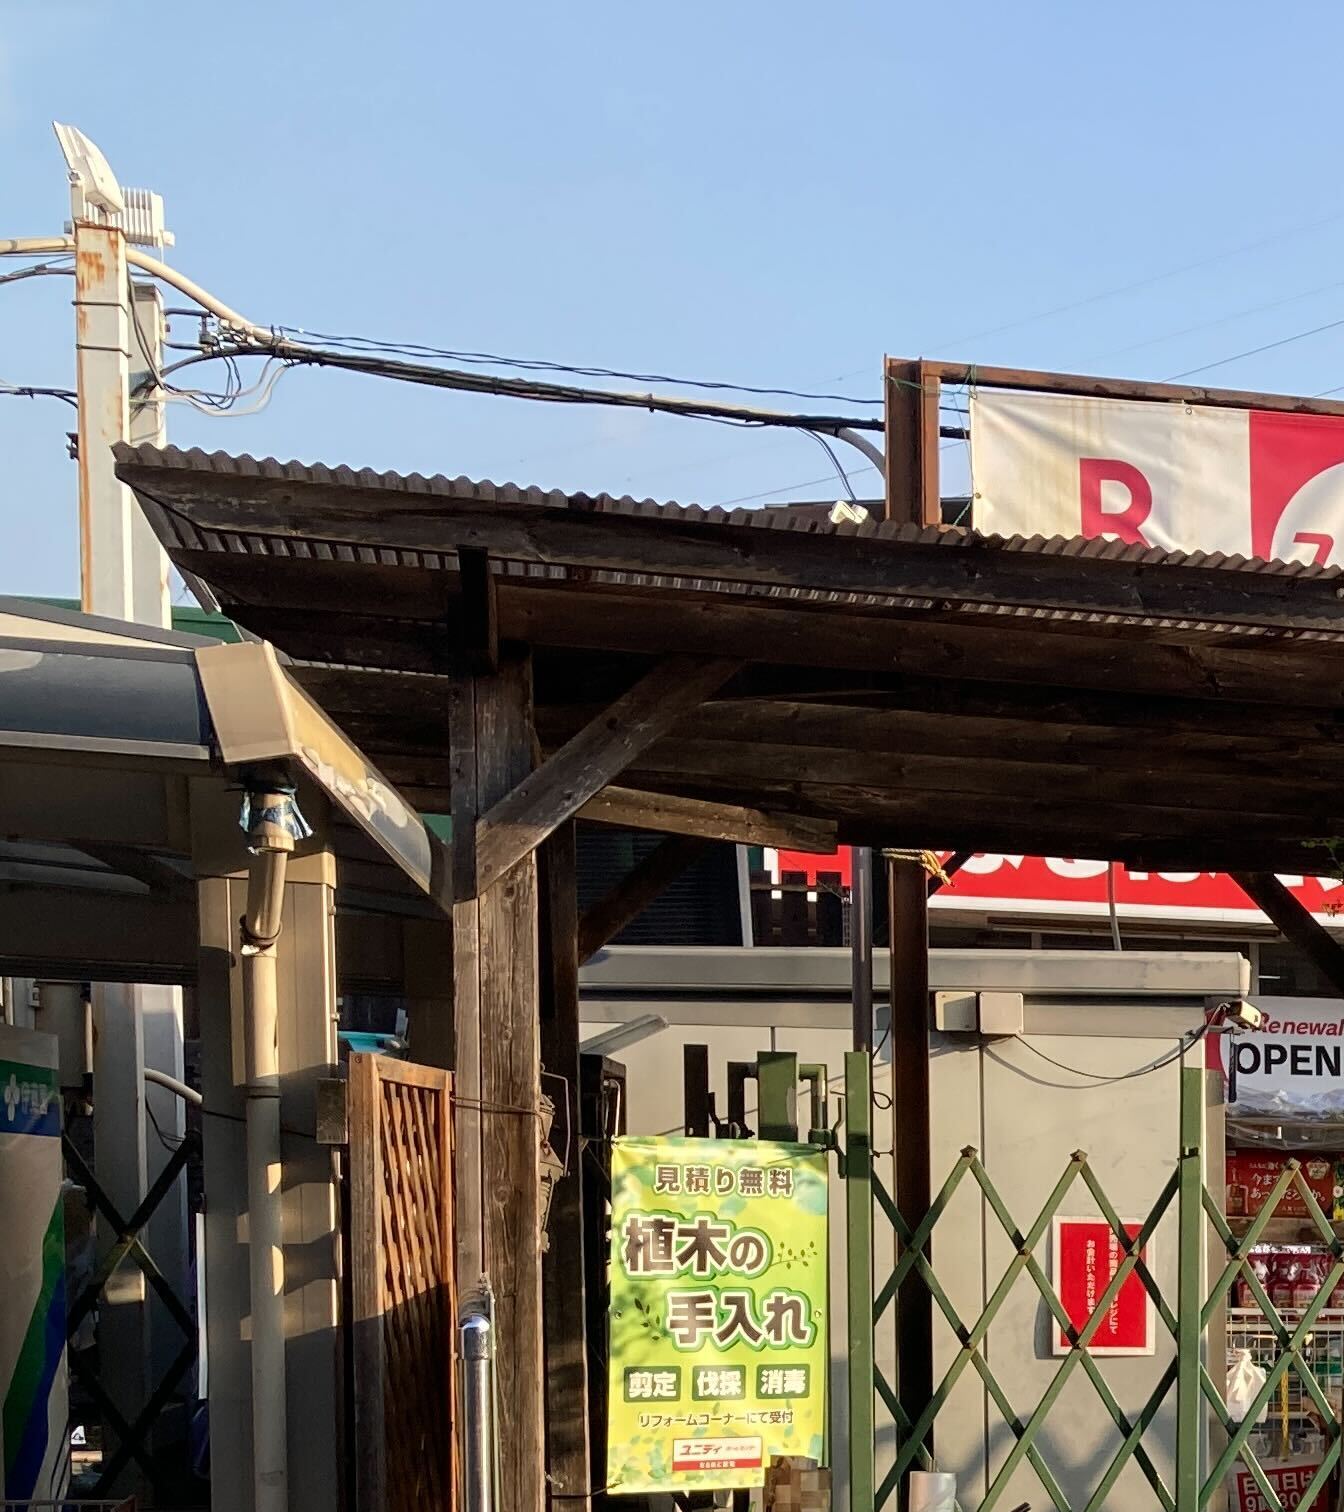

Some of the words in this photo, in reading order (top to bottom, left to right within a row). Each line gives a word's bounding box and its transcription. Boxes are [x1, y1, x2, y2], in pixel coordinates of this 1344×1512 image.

[655, 1165, 793, 1195] 見積り無料
[625, 1217, 764, 1272] 植木の
[669, 1293, 809, 1344] 手入れ
[629, 1370, 677, 1398] 剪定
[697, 1370, 741, 1396] 伐採
[761, 1369, 806, 1394] 消毒
